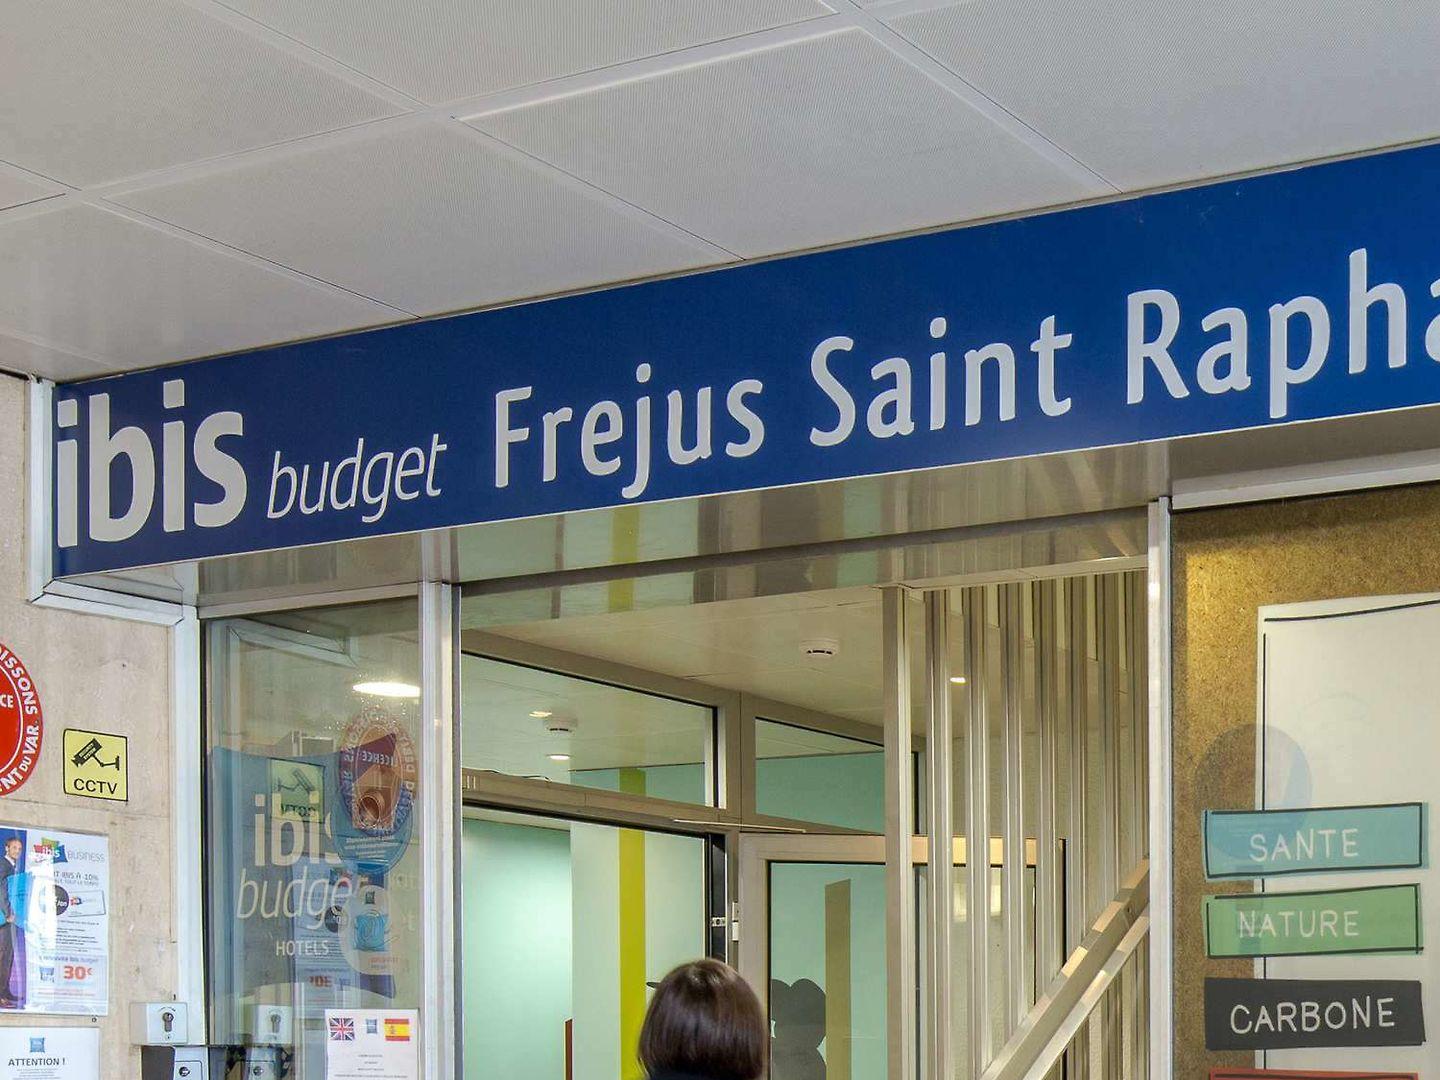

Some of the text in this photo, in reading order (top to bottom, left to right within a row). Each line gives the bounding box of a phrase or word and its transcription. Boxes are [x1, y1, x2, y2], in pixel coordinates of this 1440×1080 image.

[57, 378, 248, 549] ibis
[266, 432, 448, 524] budget
[495, 362, 766, 500] Frejus
[809, 315, 1073, 448] Saint
[74, 778, 117, 794] CCTV
[1249, 827, 1360, 863] SANTE
[1238, 909, 1360, 939] NATURE
[276, 940, 329, 956] HOTELS
[1229, 997, 1396, 1035] CARBONE
[8, 1058, 59, 1066] ATTENTION
